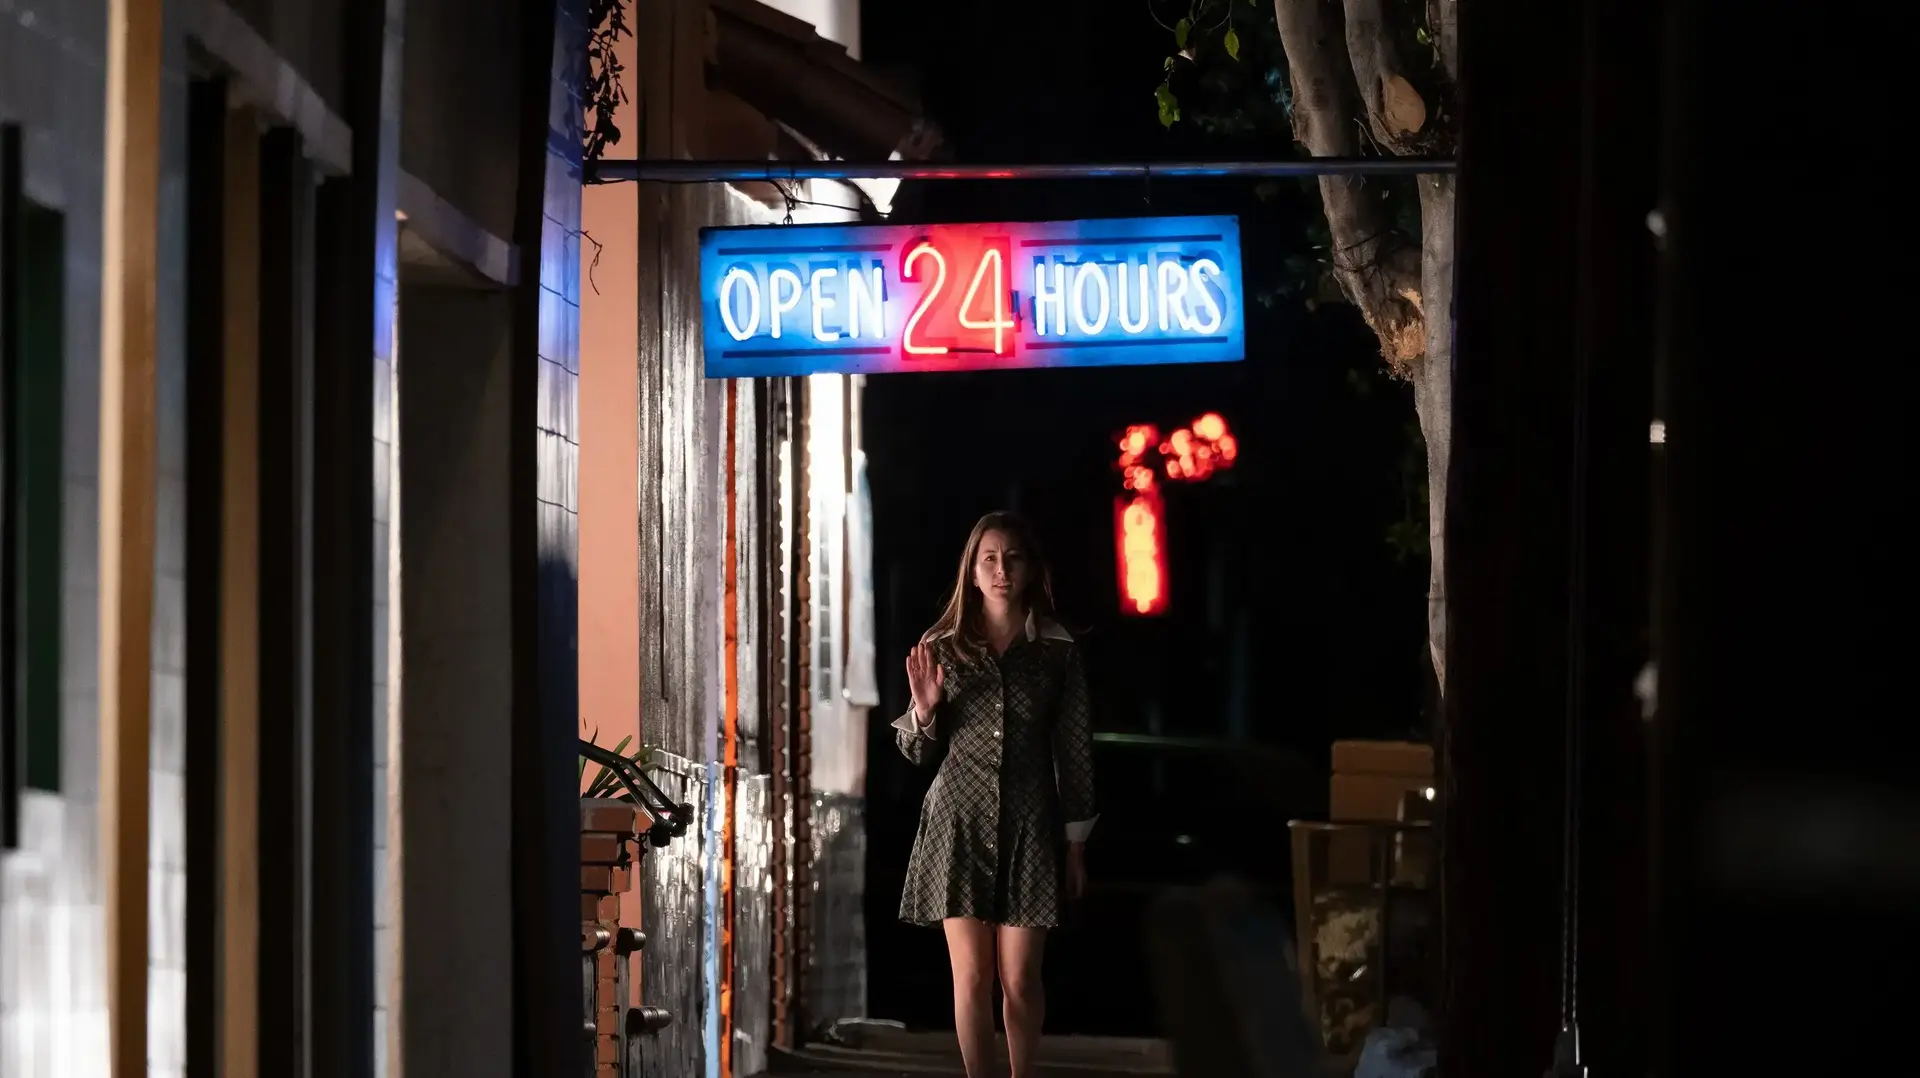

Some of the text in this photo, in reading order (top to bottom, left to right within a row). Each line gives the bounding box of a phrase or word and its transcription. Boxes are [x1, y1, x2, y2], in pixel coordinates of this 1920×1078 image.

[718, 241, 1222, 355] OPEN 24 HOURS
